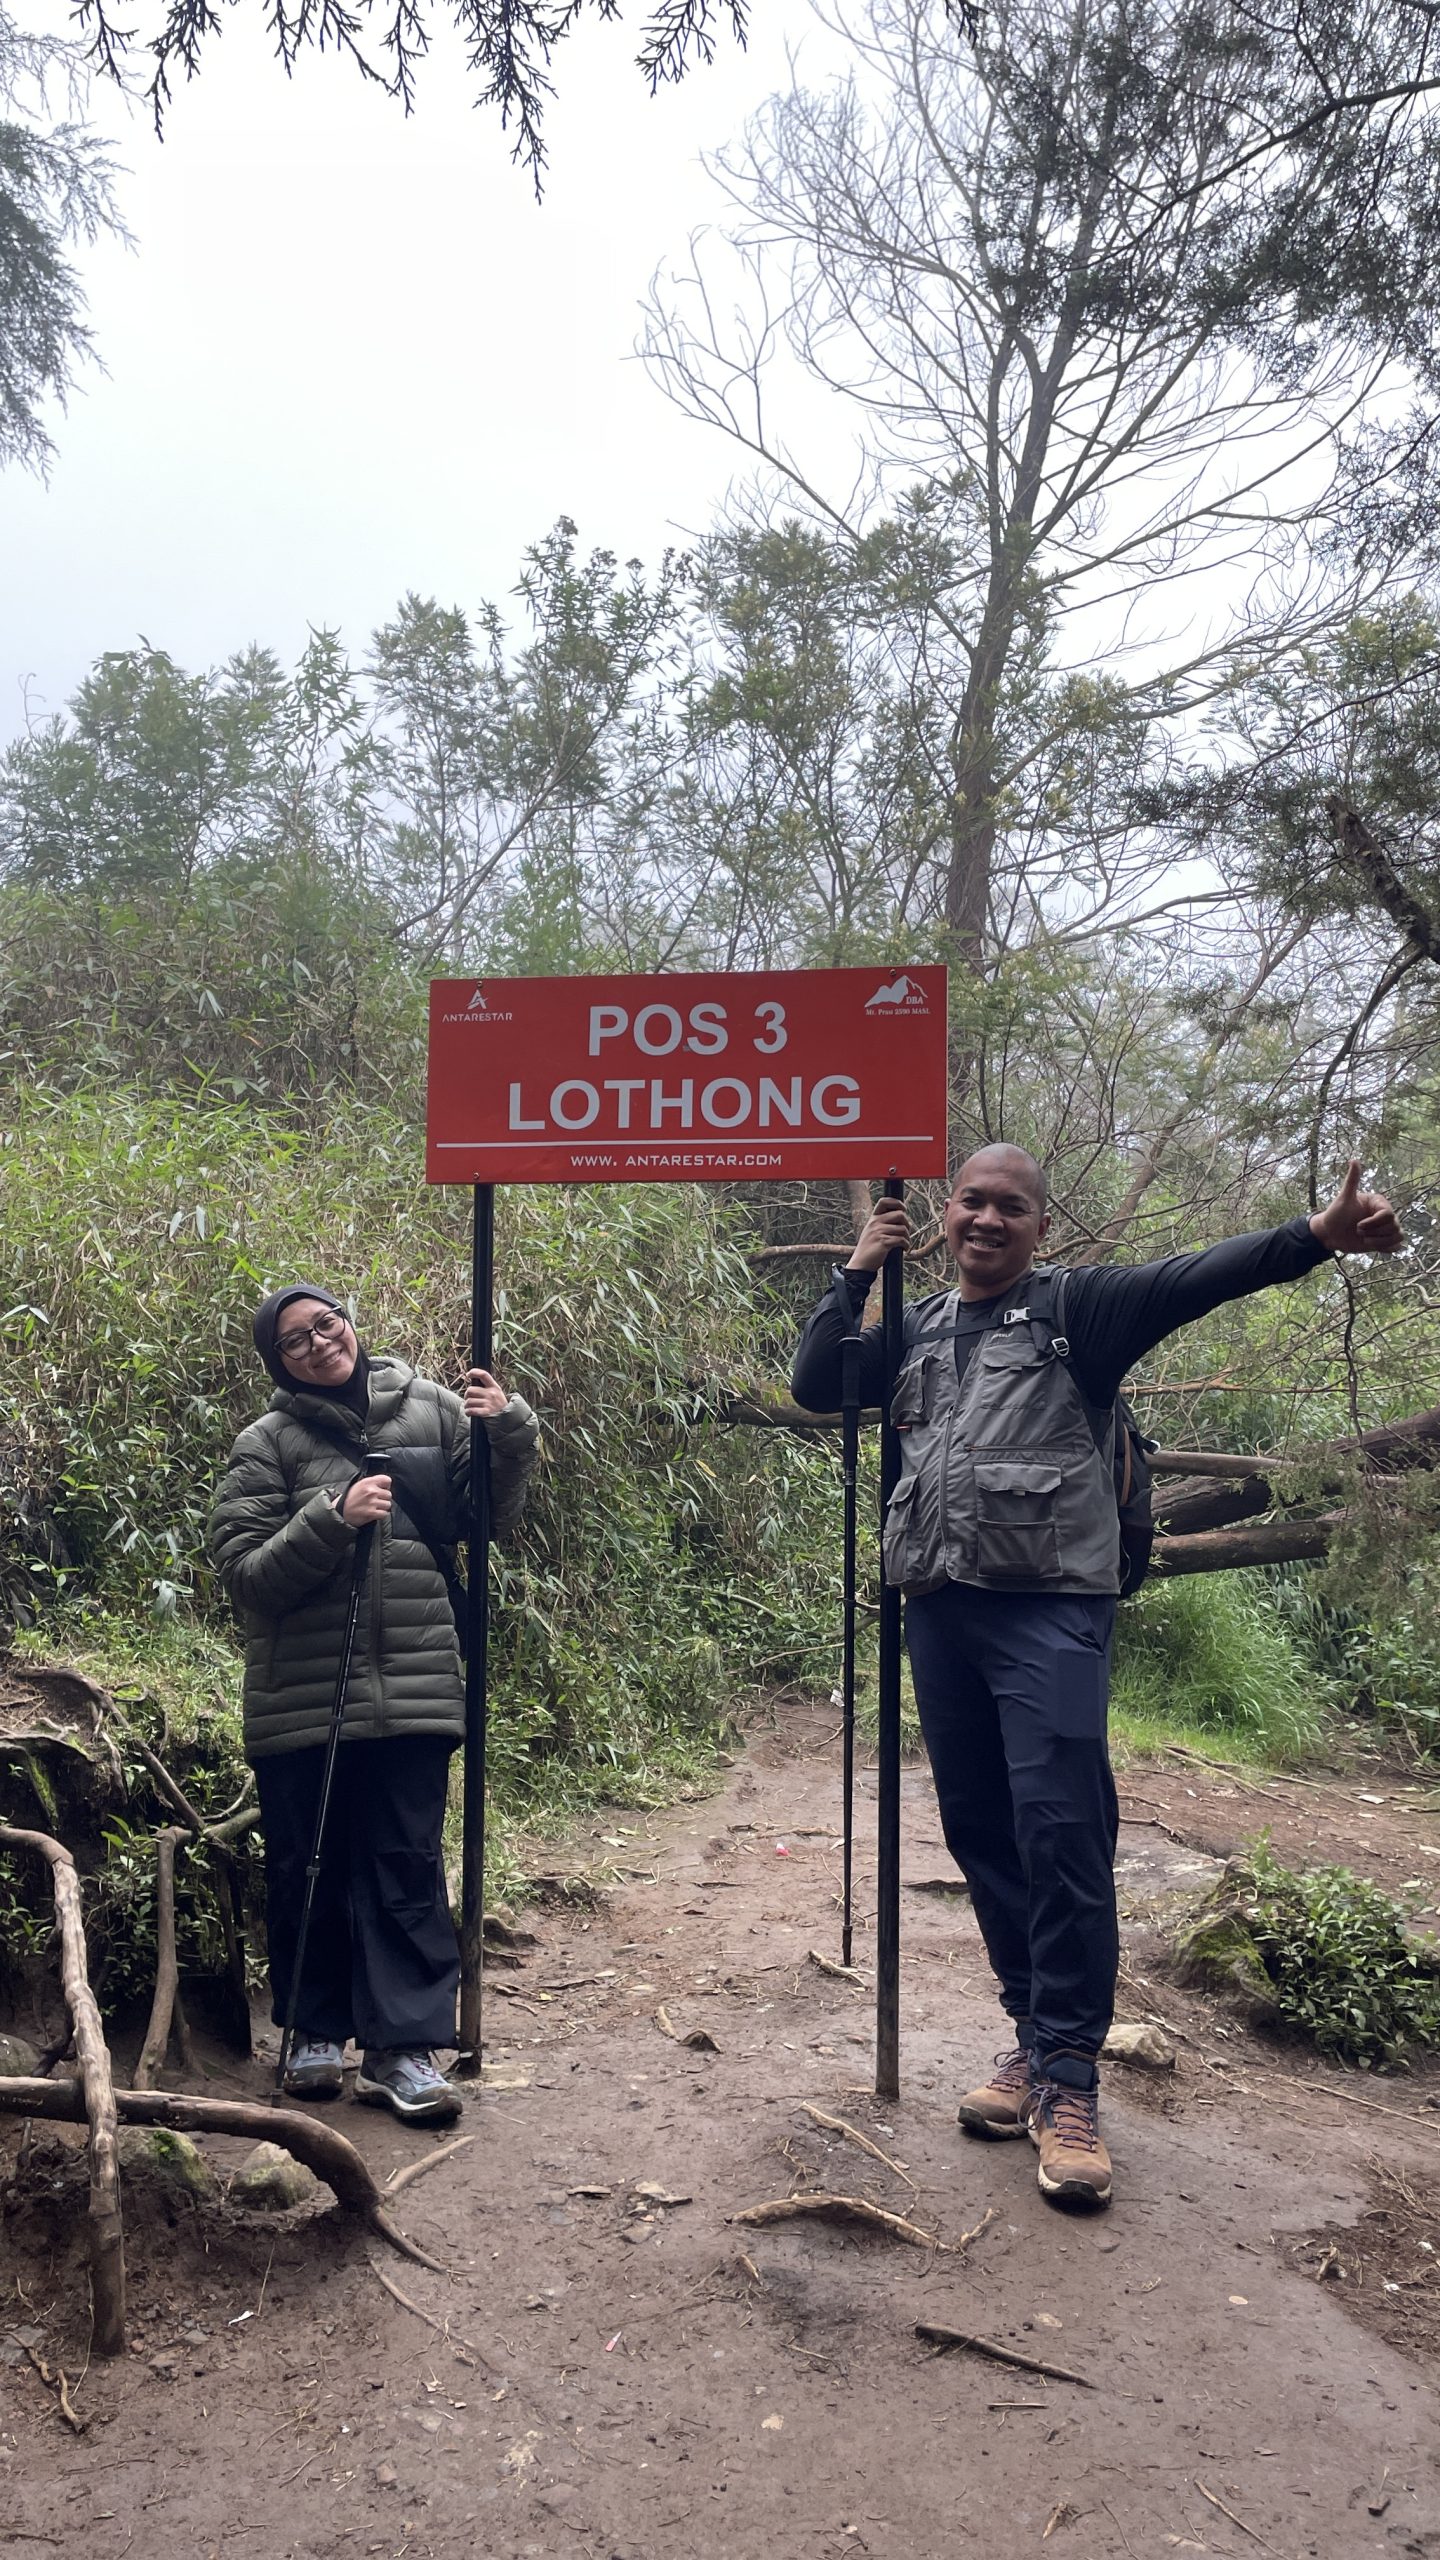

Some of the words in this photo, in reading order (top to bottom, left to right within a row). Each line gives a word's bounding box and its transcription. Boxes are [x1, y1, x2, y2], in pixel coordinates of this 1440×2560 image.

[906, 996, 924, 1005] DBA
[442, 1012, 513, 1023] ANTARESTAR
[588, 1002, 729, 1056] POS
[753, 1001, 788, 1054] 3
[508, 1074, 861, 1131] LOTHONG
[570, 1155, 618, 1167] WWW.
[625, 1154, 783, 1167] ANTARESTAR.COM
